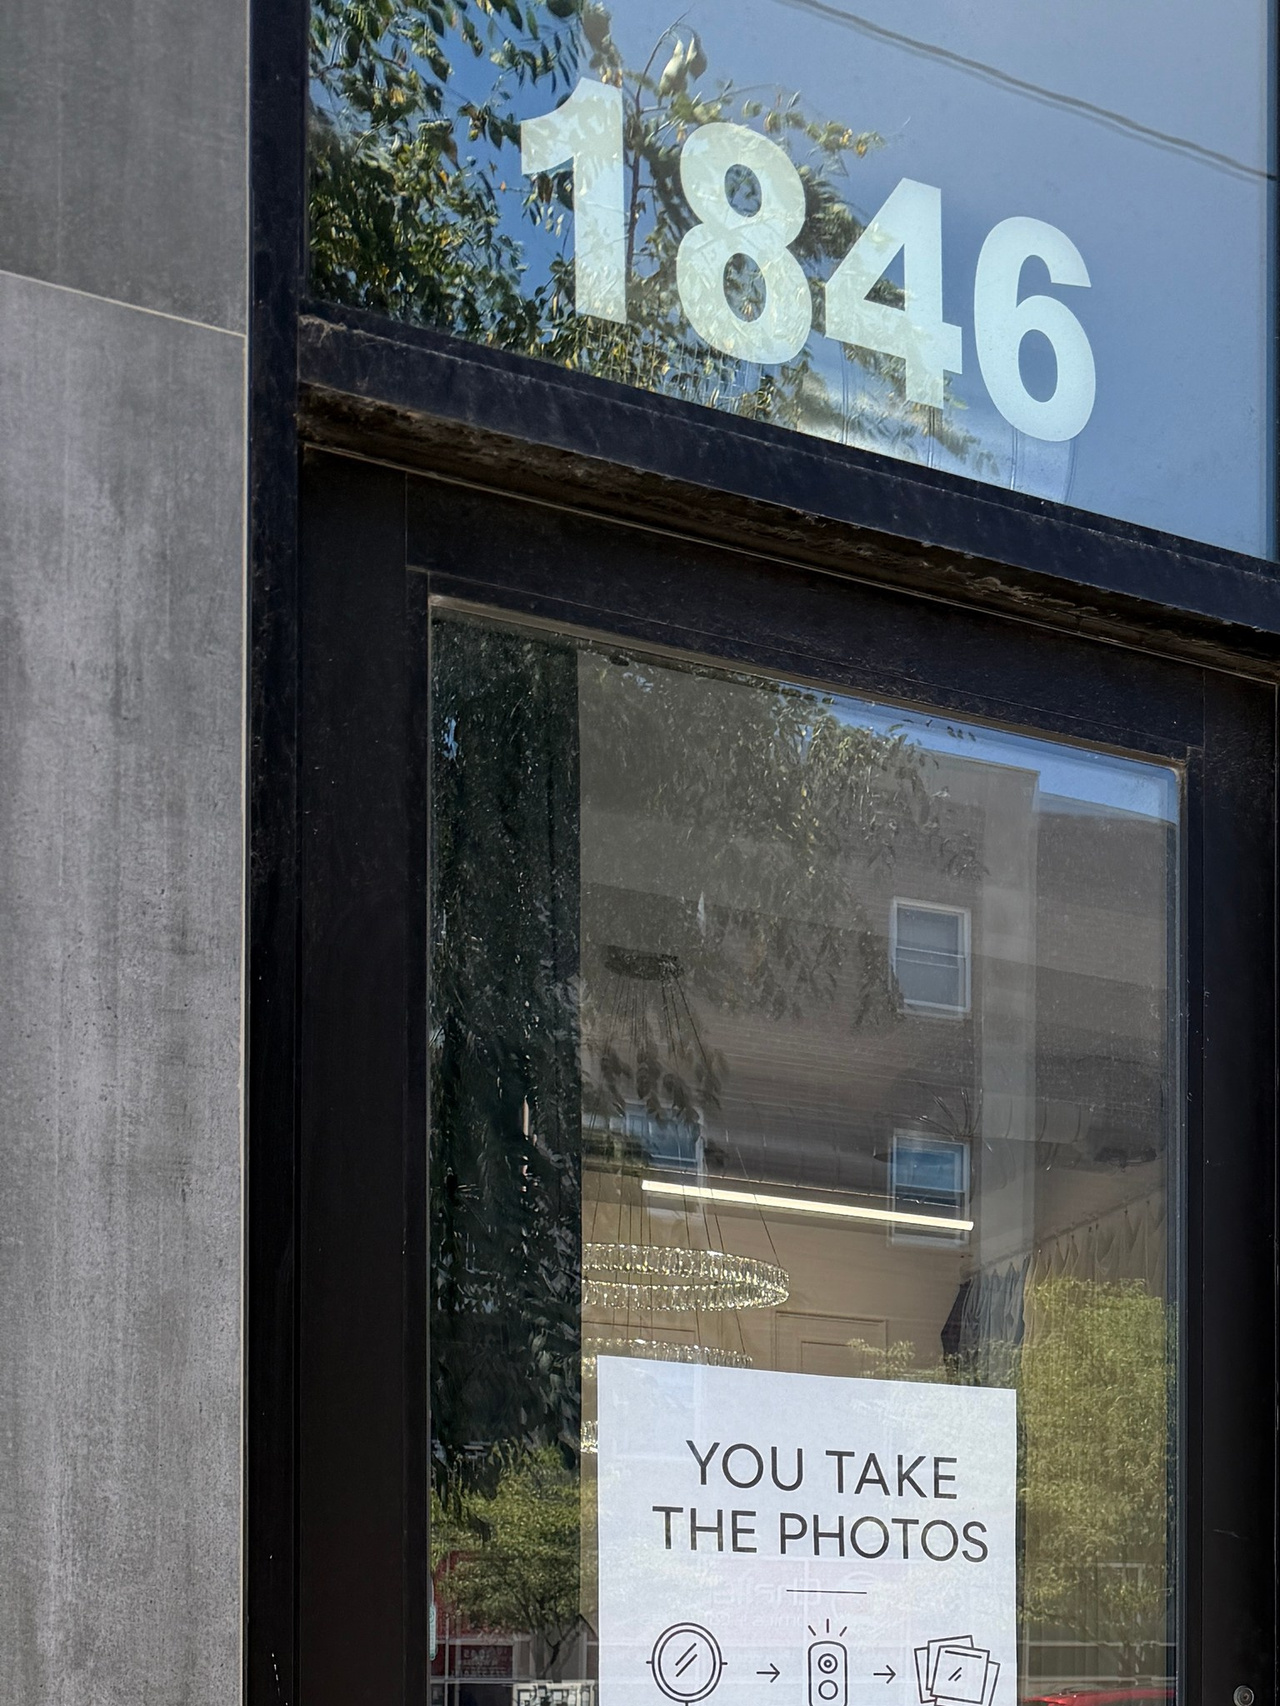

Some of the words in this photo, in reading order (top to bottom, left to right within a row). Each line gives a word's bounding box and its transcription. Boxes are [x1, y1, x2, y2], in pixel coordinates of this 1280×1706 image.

[521, 77, 1096, 441] 1846
[686, 1440, 803, 1491] YOU
[826, 1450, 957, 1499] TAKE
[652, 1506, 757, 1553] THE
[780, 1513, 988, 1562] PHOTOS
